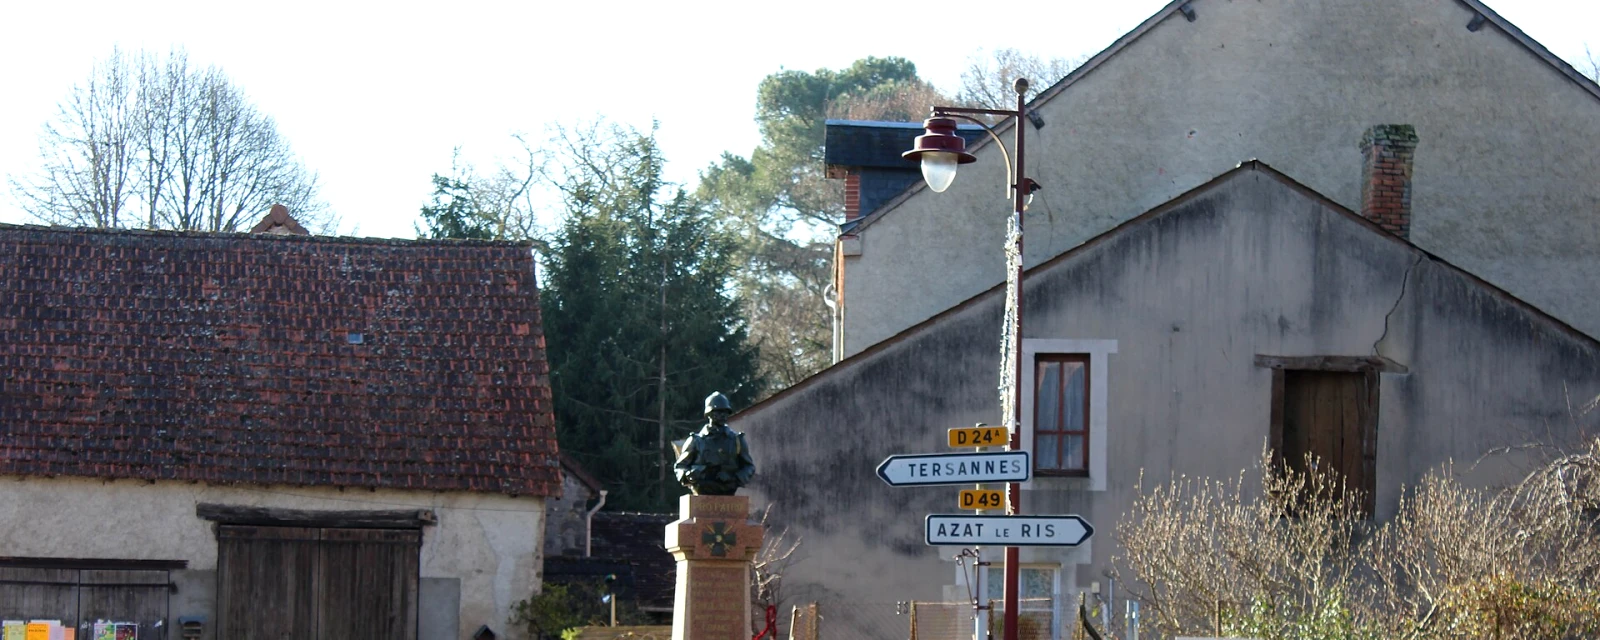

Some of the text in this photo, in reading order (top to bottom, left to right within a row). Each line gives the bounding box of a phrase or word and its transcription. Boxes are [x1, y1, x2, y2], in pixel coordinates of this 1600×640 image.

[957, 430, 967, 444] D
[908, 459, 1021, 477] TERSANNES
[963, 492, 1001, 506] D 49
[937, 523, 1055, 538] AZAT LE RIS
